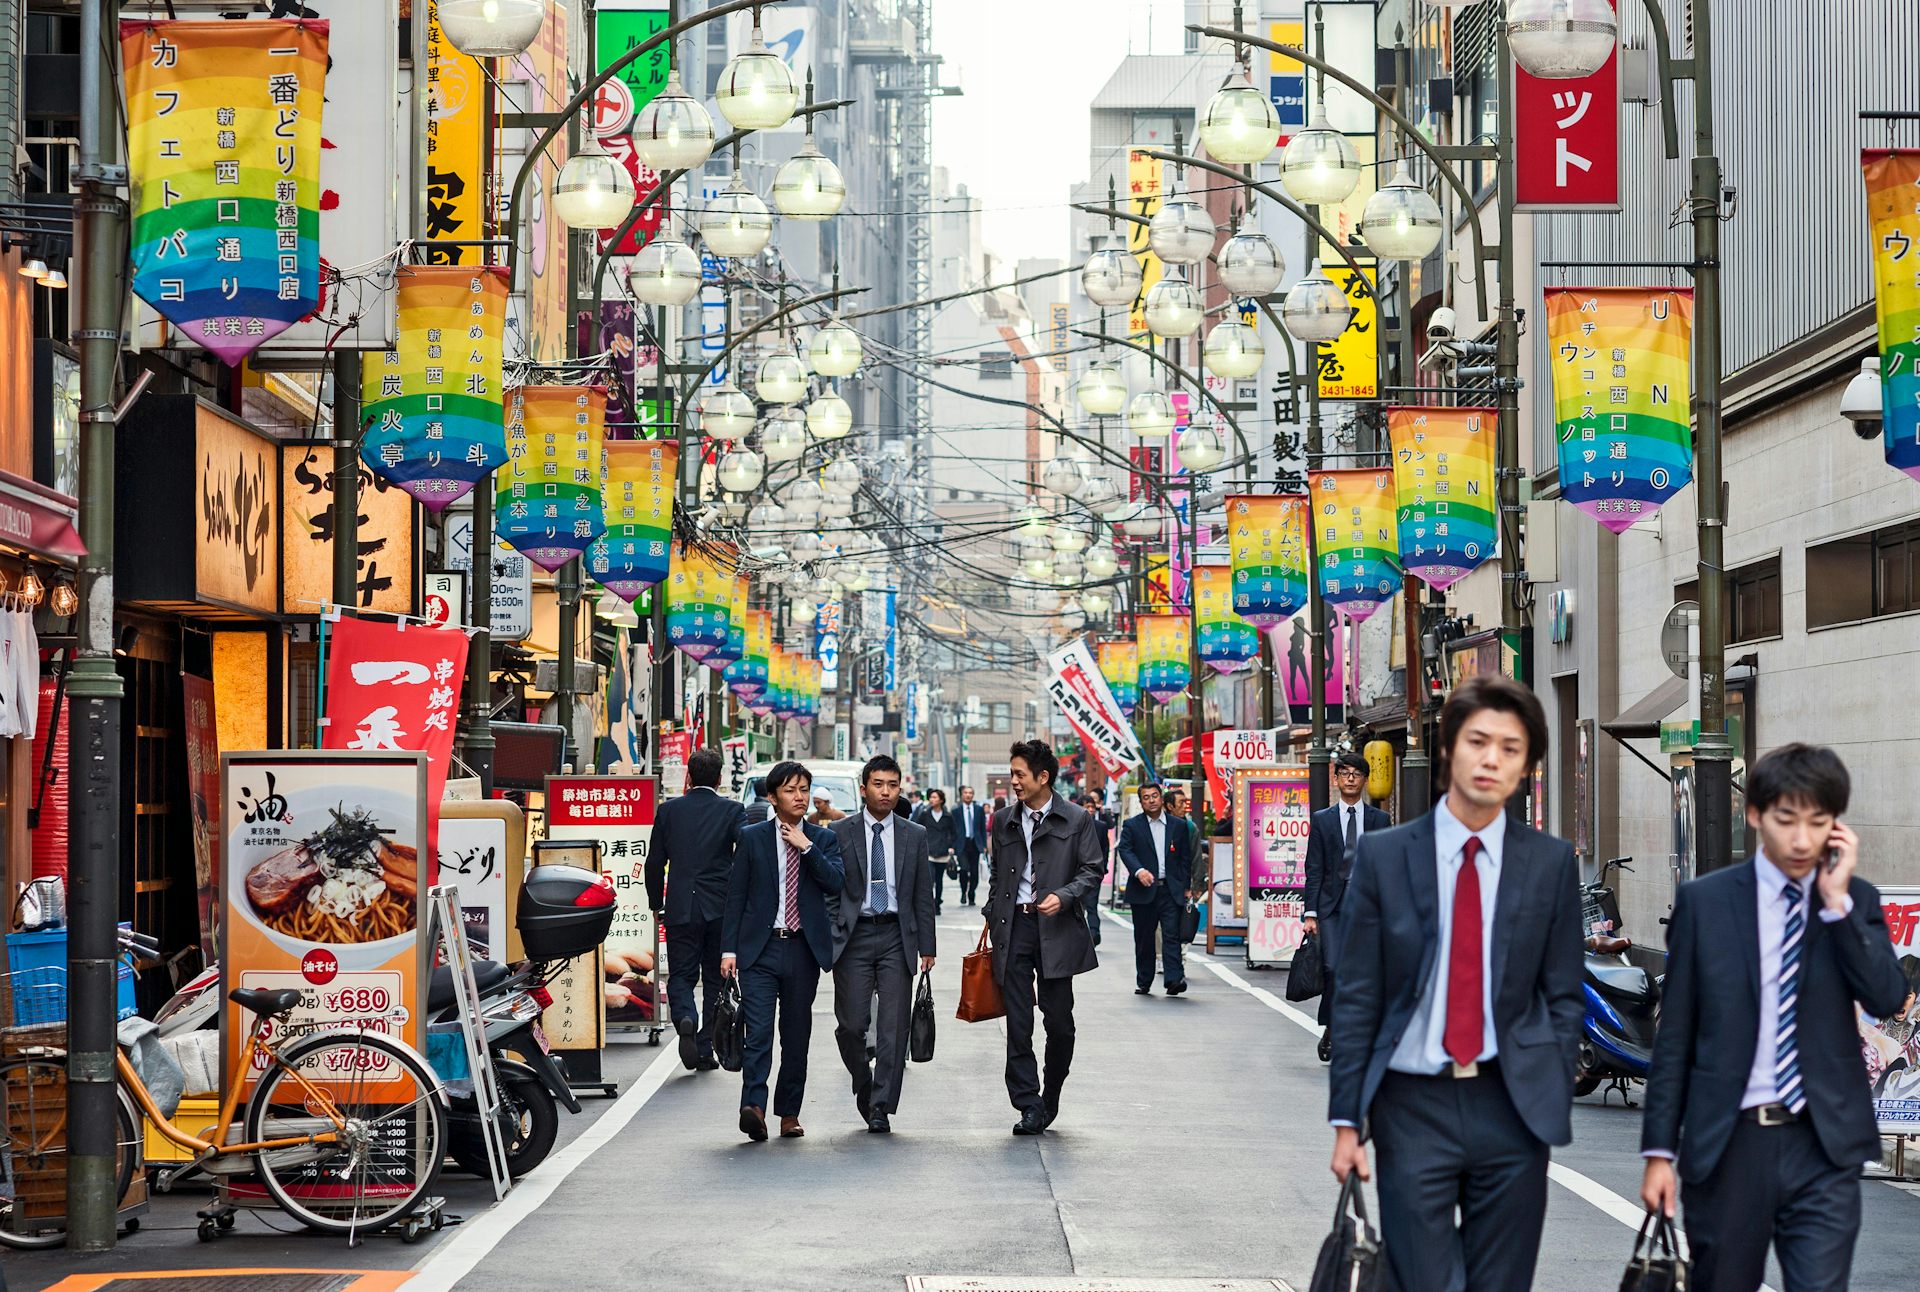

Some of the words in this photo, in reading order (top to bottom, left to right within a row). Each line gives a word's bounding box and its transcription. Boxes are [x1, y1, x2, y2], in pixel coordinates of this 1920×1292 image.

[649, 19, 664, 84] レタル
[151, 38, 188, 301] カフェトバコ
[268, 46, 300, 300] 一番どり新橋西口店
[214, 108, 242, 300] 新橋西口通り
[203, 317, 264, 336] 共栄会
[465, 277, 488, 467] らあめん北斗
[1321, 386, 1374, 395] 3431-1845
[1650, 299, 1669, 489] UNO
[425, 329, 444, 467] 新橋西口通り
[1609, 348, 1628, 488] 新橋西口通り
[414, 480, 460, 493] 共栄会
[543, 433, 558, 539] 新橋西口通り
[574, 395, 592, 538] 中華料理味之苑
[1464, 416, 1480, 560] UNO
[1435, 453, 1449, 557] 新橋西口通り
[1597, 499, 1642, 513] 共栄会
[562, 788, 641, 802] 築地市場より
[303, 961, 336, 972] 油そば
[324, 987, 390, 1013] ¥680
[324, 1048, 390, 1071] ¥780
[387, 1119, 406, 1127] ¥100
[387, 1129, 406, 1137] ¥300
[387, 1149, 406, 1157] ¥100
[387, 1168, 406, 1176] ¥100
